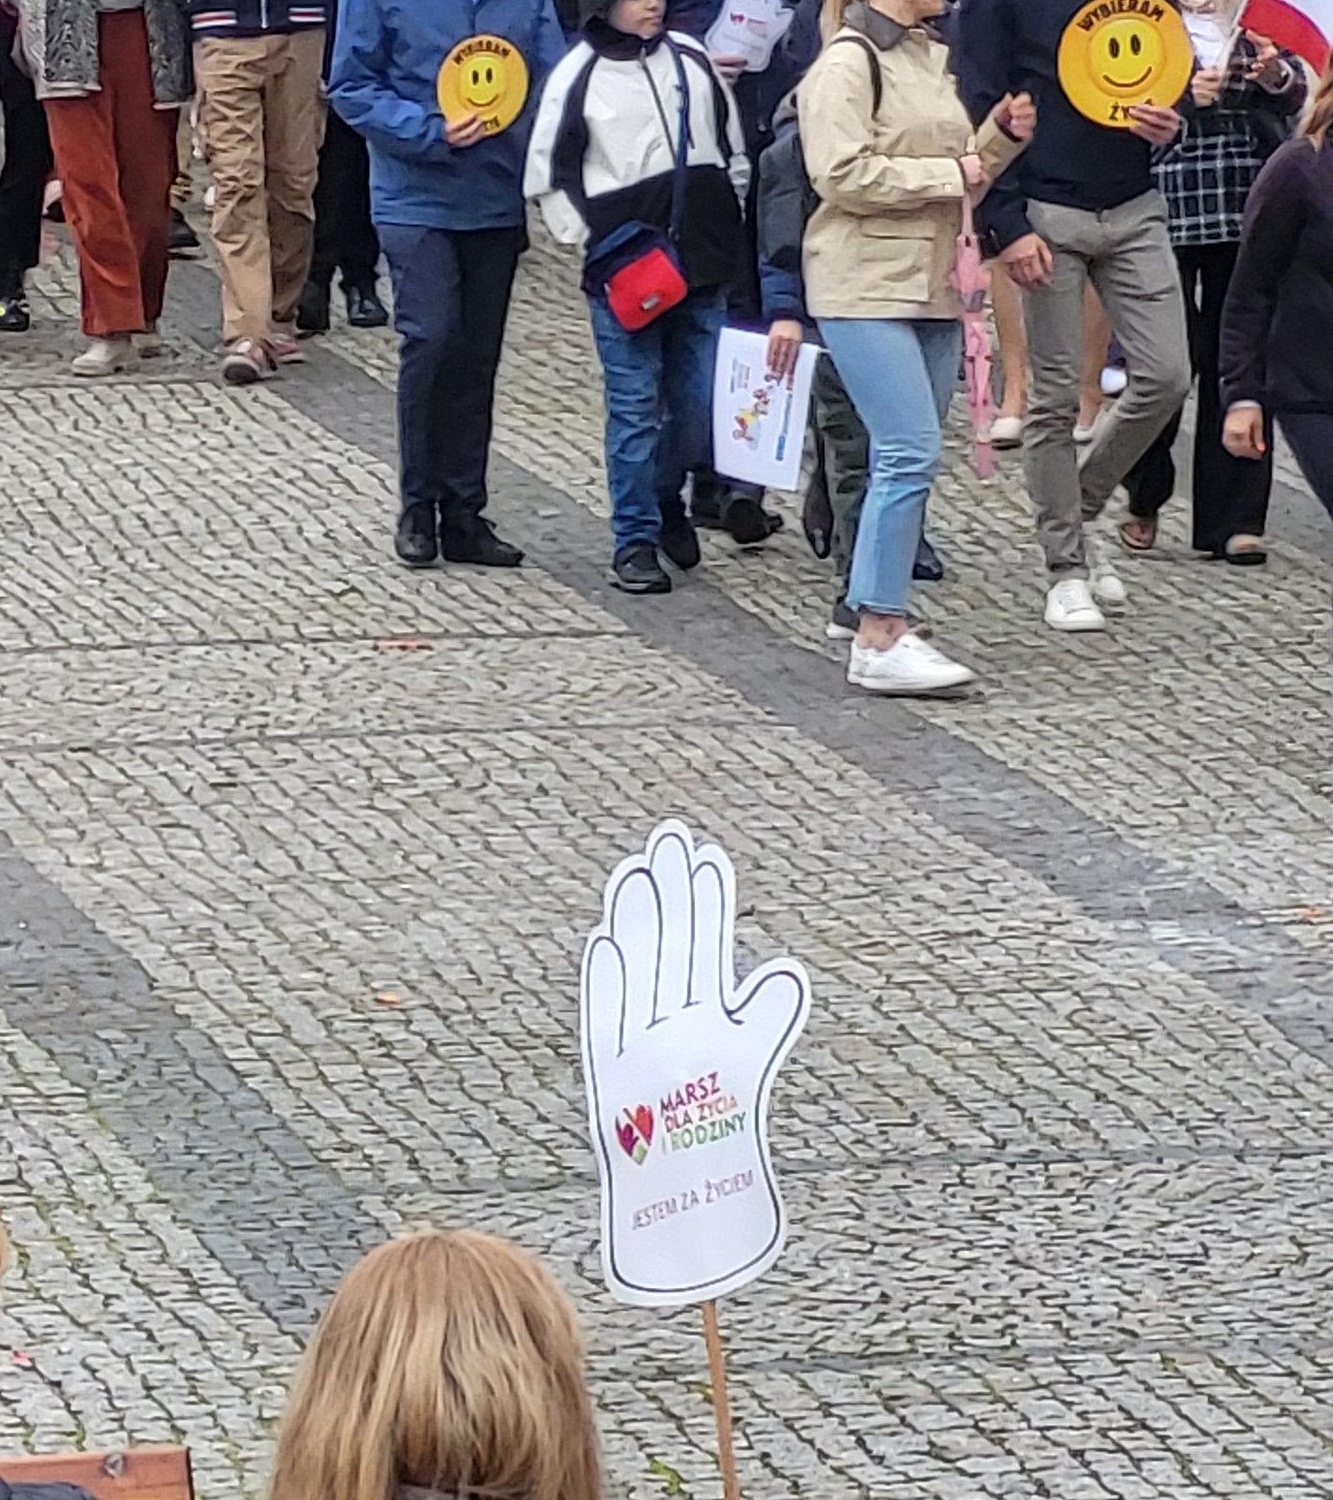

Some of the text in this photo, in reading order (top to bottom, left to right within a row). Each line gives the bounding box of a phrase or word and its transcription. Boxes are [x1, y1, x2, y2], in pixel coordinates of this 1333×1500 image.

[659, 1071, 721, 1118] MARSZ
[664, 1109, 693, 1134] DLA
[669, 1110, 747, 1152] RODZINY
[632, 1168, 754, 1231] JESTEM ZA ŻYCIEM
